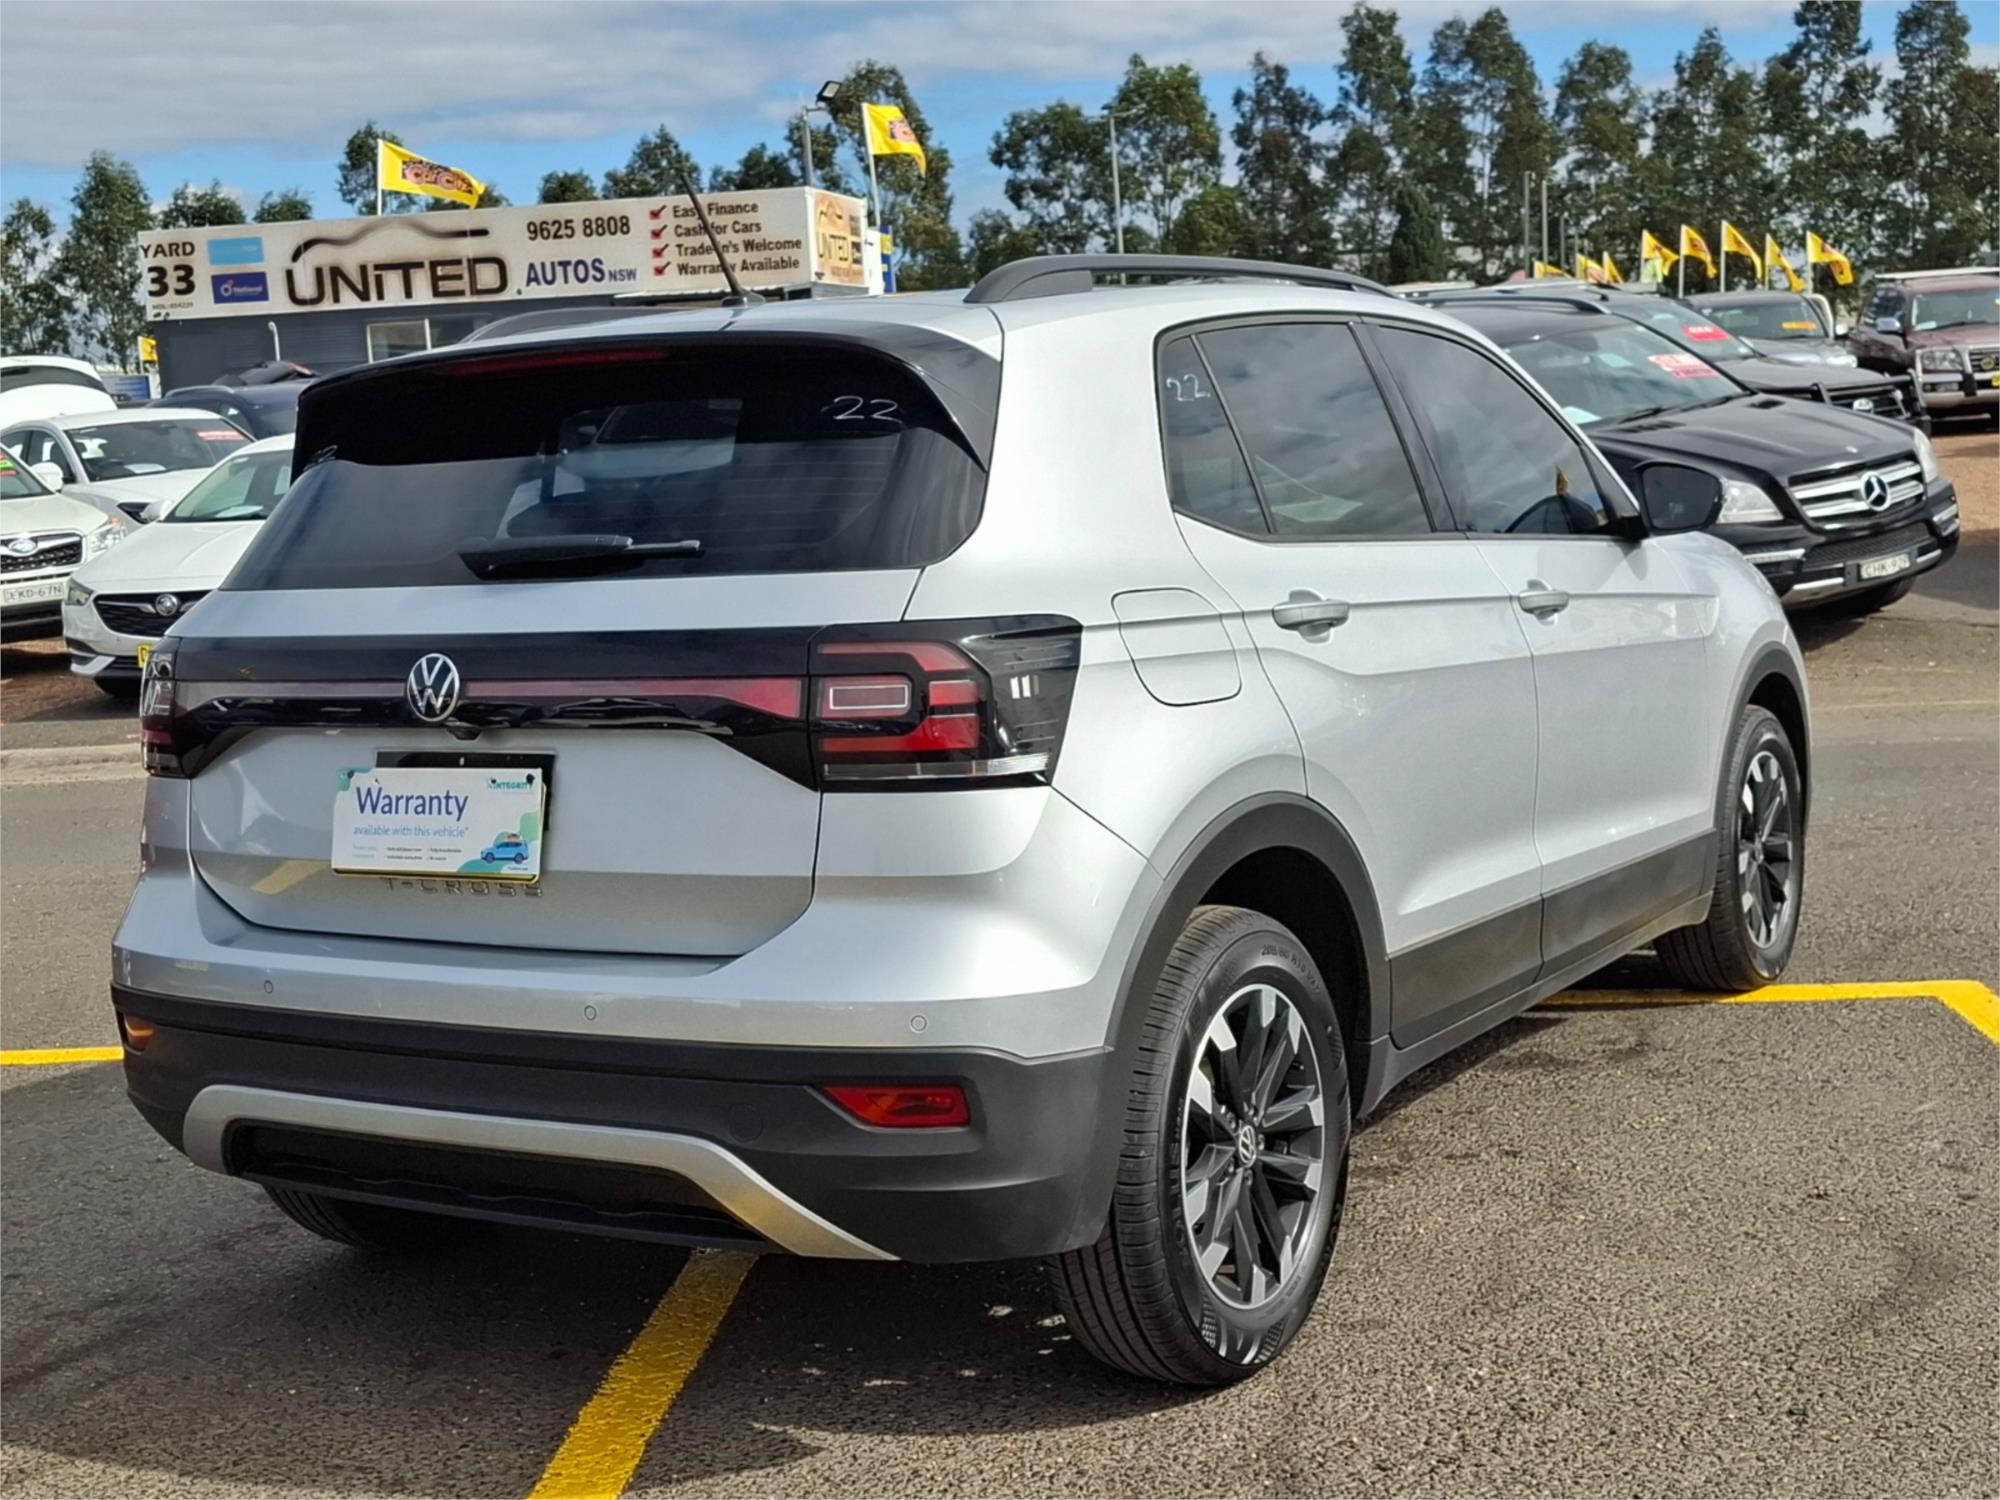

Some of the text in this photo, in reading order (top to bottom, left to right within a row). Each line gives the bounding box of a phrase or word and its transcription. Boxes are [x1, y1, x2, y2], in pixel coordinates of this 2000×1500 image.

[707, 202, 759, 216] Finance
[527, 215, 631, 241] 9625 8808
[732, 219, 762, 234] Cars
[140, 241, 196, 259] YARD
[742, 238, 803, 253] Welcome
[526, 258, 637, 287] AUTOS NSW
[740, 256, 800, 272] Available
[147, 263, 196, 298] 33
[1166, 373, 1211, 402] 22
[831, 395, 903, 423] 22
[356, 786, 469, 822] Warranty
[353, 824, 390, 836] available
[391, 824, 412, 836] with
[414, 825, 432, 837] this
